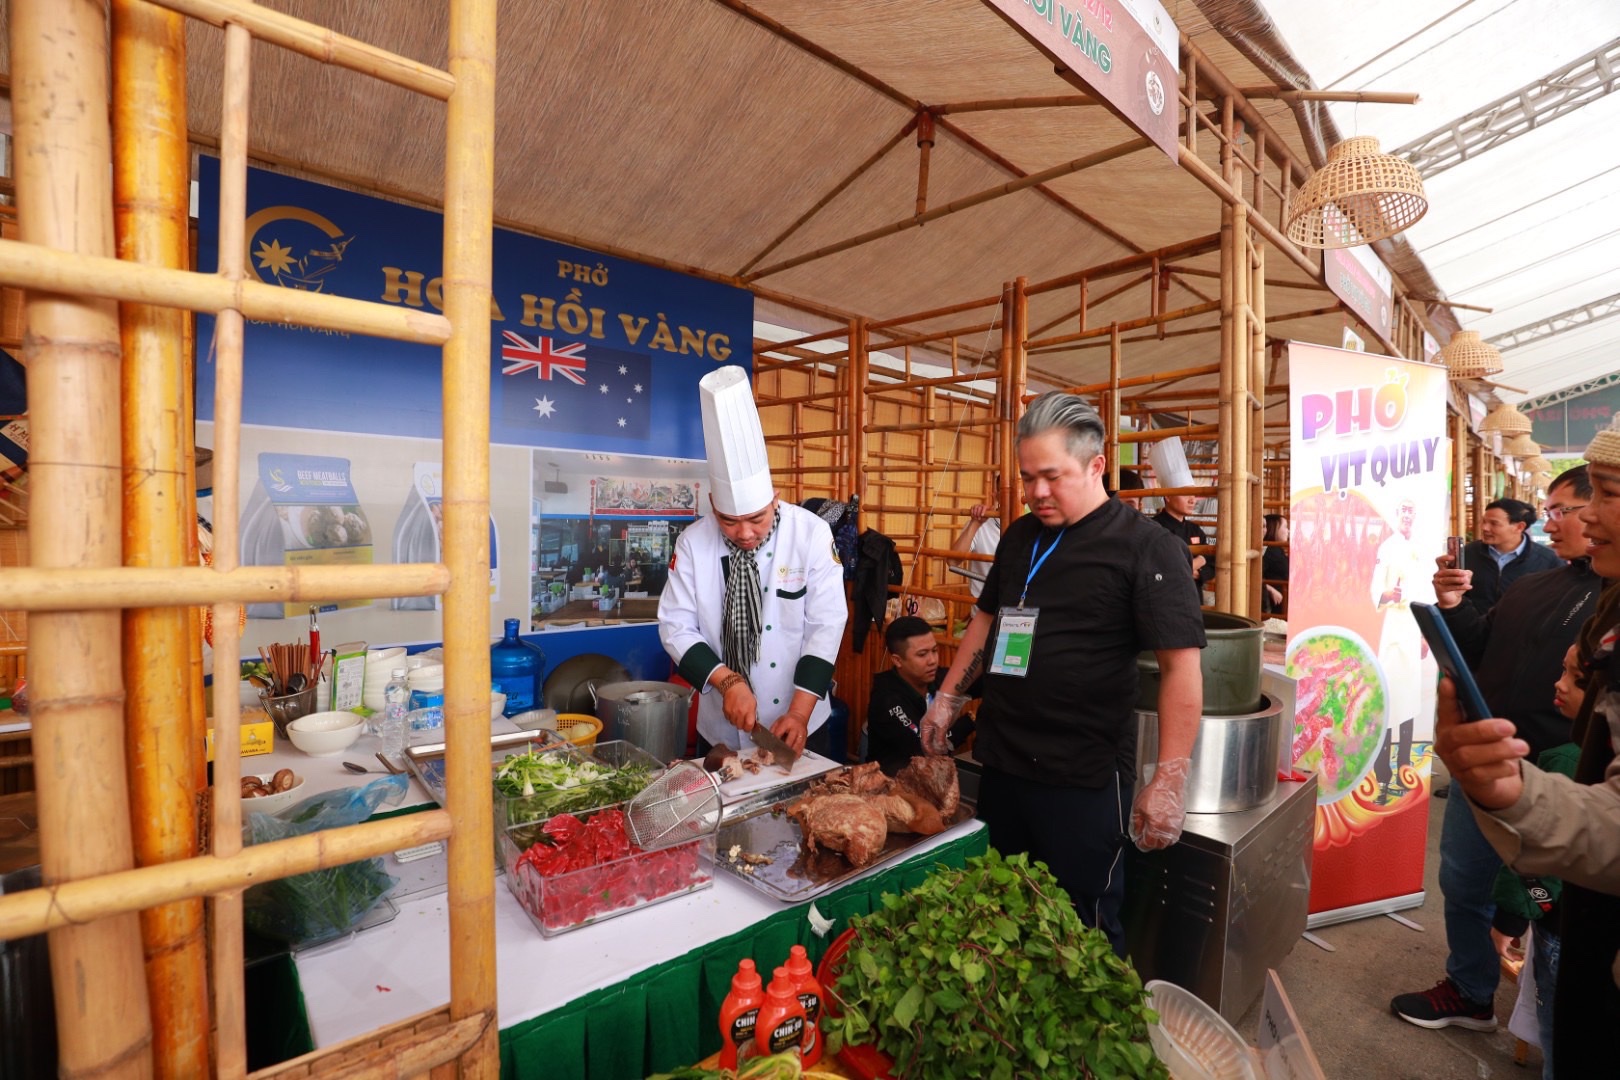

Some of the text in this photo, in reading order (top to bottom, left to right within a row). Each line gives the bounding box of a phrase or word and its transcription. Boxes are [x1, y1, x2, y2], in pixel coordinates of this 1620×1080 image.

[1058, 3, 1113, 74] VÀNG
[557, 259, 609, 287] PHỞ
[519, 287, 606, 339] HỒI
[617, 312, 732, 362] VÀNG
[1301, 367, 1409, 441] PHỞ
[1320, 436, 1441, 498] VỊT QUAY
[773, 1019, 802, 1038] CHIN-SU
